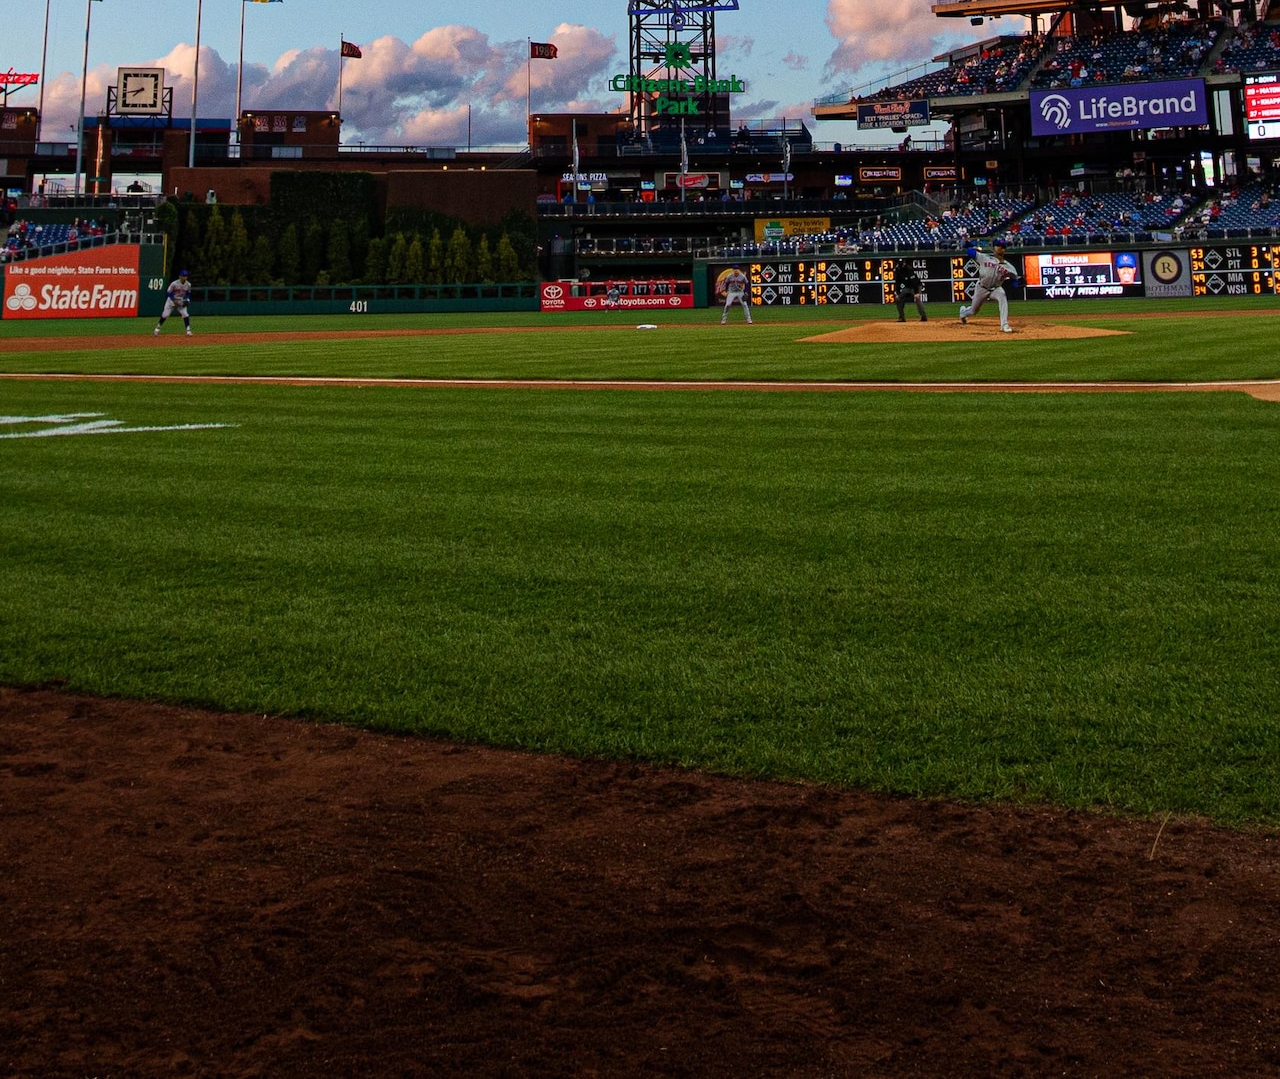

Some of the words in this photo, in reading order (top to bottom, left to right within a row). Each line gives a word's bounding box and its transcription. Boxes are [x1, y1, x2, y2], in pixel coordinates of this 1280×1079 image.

[612, 74, 690, 93] Citizens
[694, 74, 743, 93] Bank
[656, 96, 700, 115] Park
[1079, 90, 1197, 120] LifeBrand
[562, 173, 588, 181] SEAONS
[589, 172, 607, 181] PIZZA
[1225, 248, 1242, 257] STL
[913, 259, 927, 268] CLE
[1053, 256, 1088, 265] STROMAN
[1228, 260, 1241, 269] PIT
[10, 265, 23, 274] Like
[30, 266, 46, 276] good
[47, 266, 76, 276] neighbor,
[77, 266, 94, 274] State
[95, 266, 111, 275] Farm
[118, 266, 136, 275] there.
[778, 264, 792, 272] DET
[844, 262, 858, 270] ATL
[1161, 262, 1173, 273] R
[778, 274, 792, 282] NYY
[844, 272, 859, 281] TOR
[1227, 273, 1244, 282] MIA
[148, 278, 163, 290] 409
[845, 284, 859, 293] BOS
[1146, 283, 1191, 293] ROTHMAN
[779, 286, 793, 294] HOU
[1045, 286, 1076, 298] xfinity
[1078, 286, 1099, 296] PITCH
[1099, 285, 1124, 295] SPEED
[1227, 284, 1247, 295] WSH
[846, 295, 859, 304] TEX
[349, 301, 368, 313] 401
